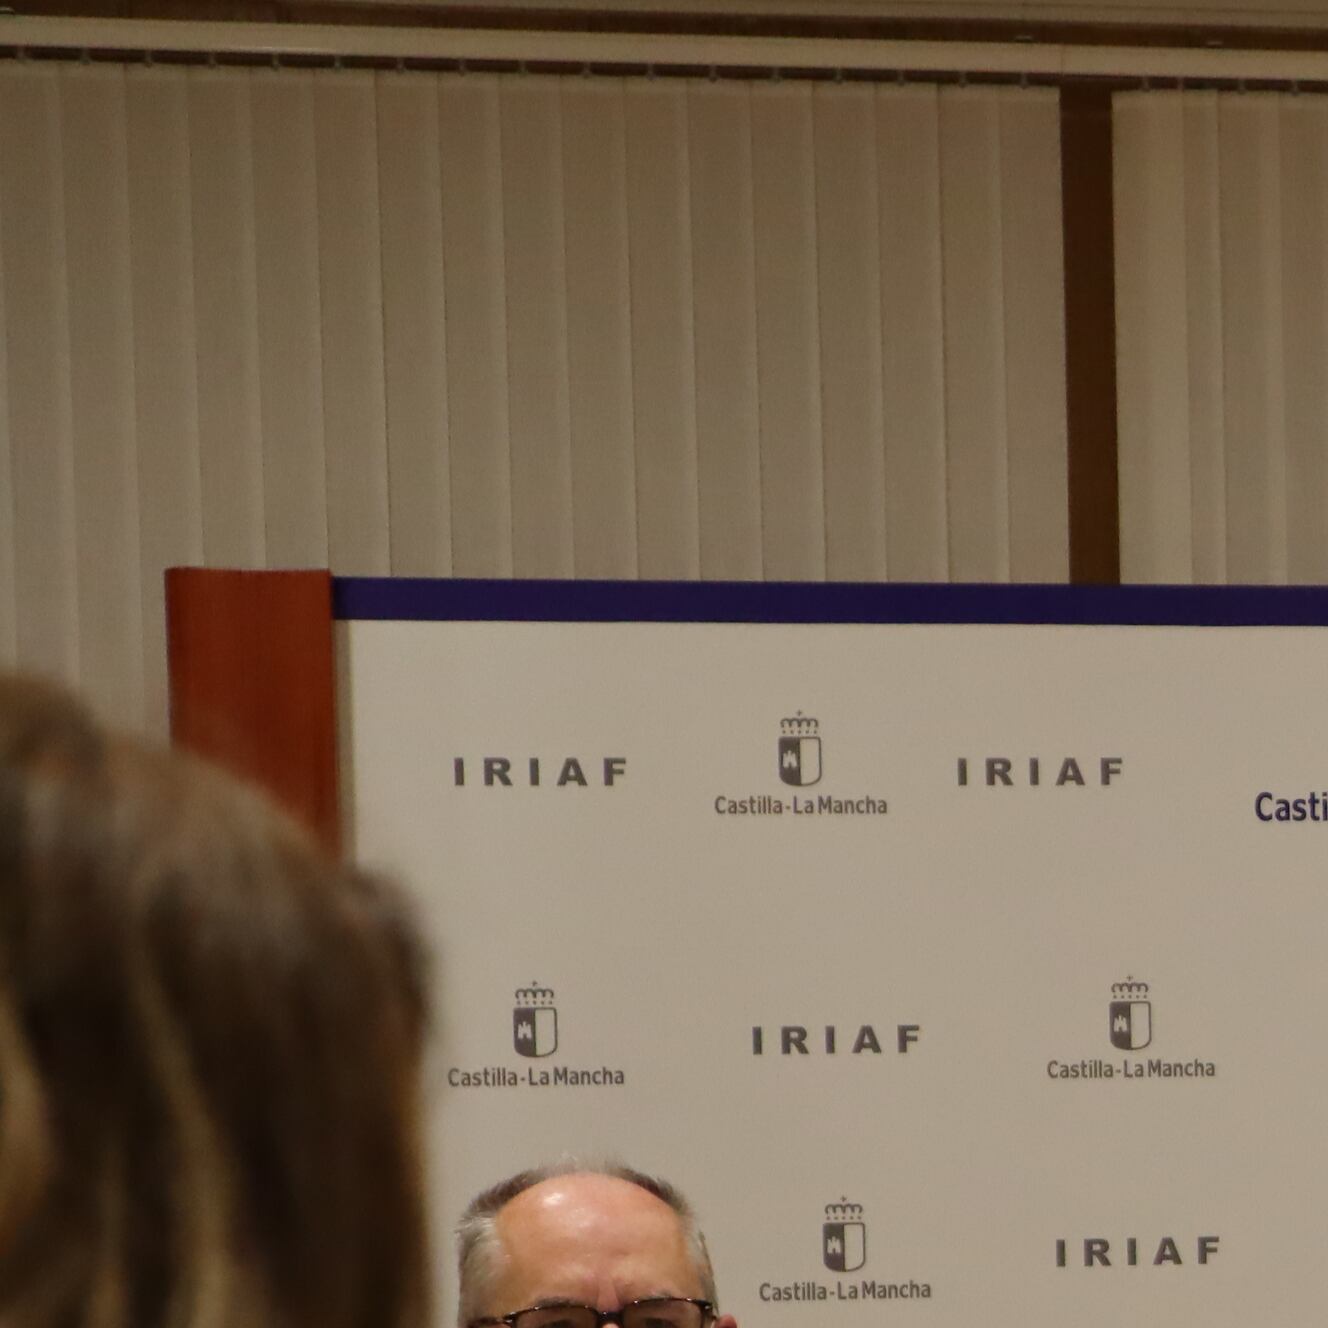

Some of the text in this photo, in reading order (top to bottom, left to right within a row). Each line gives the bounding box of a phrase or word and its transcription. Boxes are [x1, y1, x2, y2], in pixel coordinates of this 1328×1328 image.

[454, 758, 626, 786] IRIAF
[958, 758, 1122, 786] IRIAF
[715, 796, 887, 814] Castilla-La Mancha
[753, 1025, 919, 1055] IRIAF
[447, 1067, 624, 1087] Castilla-La Mancha
[1047, 1059, 1215, 1078] Castilla-La Mancha
[1056, 1237, 1219, 1267] IRIAF
[759, 1280, 931, 1301] Castilla-La Mancha
